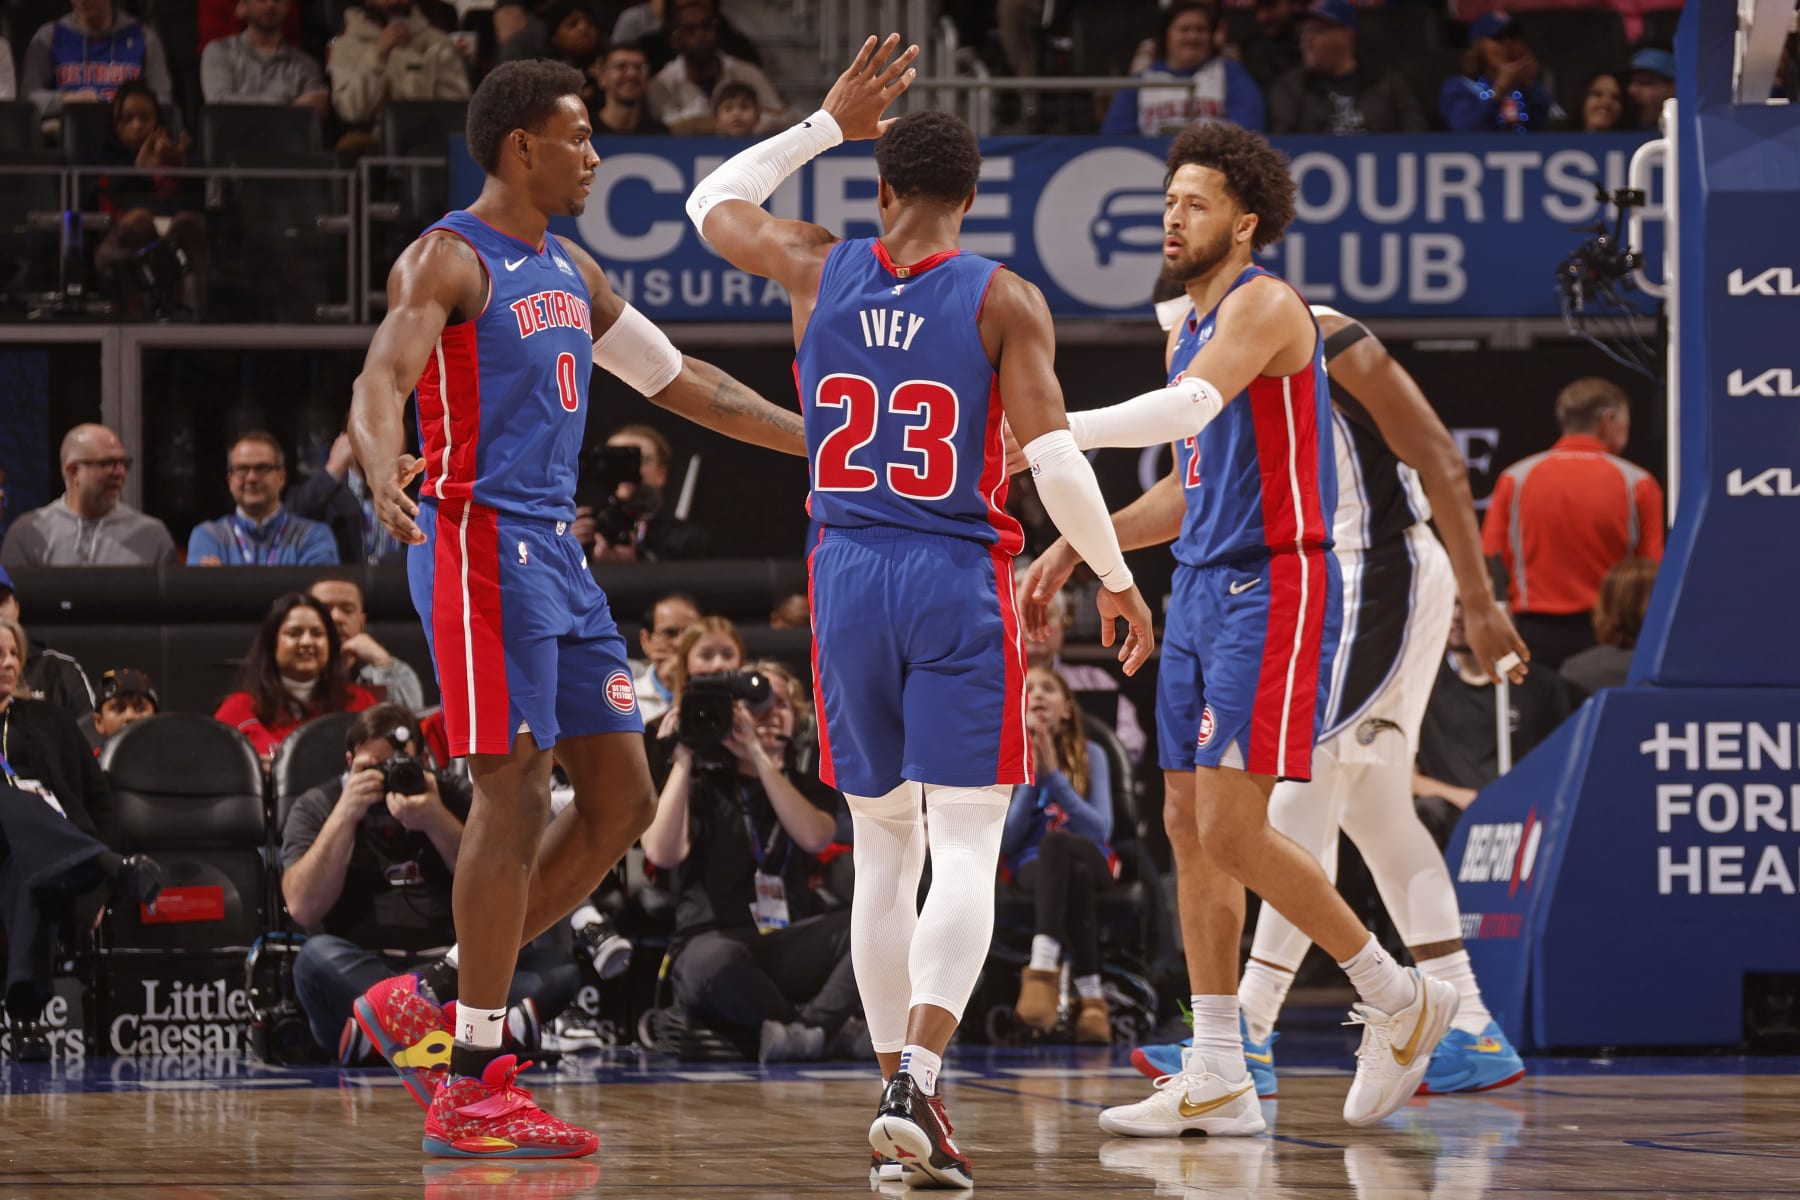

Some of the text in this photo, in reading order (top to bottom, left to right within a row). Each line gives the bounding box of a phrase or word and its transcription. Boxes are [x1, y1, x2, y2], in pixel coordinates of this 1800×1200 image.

[1259, 231, 1468, 304] LUB
[859, 308, 925, 351] IVEY
[556, 352, 579, 413] 0
[815, 373, 960, 501] 23
[1184, 435, 1202, 489] 2
[1640, 722, 1800, 771] HEN
[1657, 845, 1800, 895] HEA
[141, 979, 248, 1022] Little
